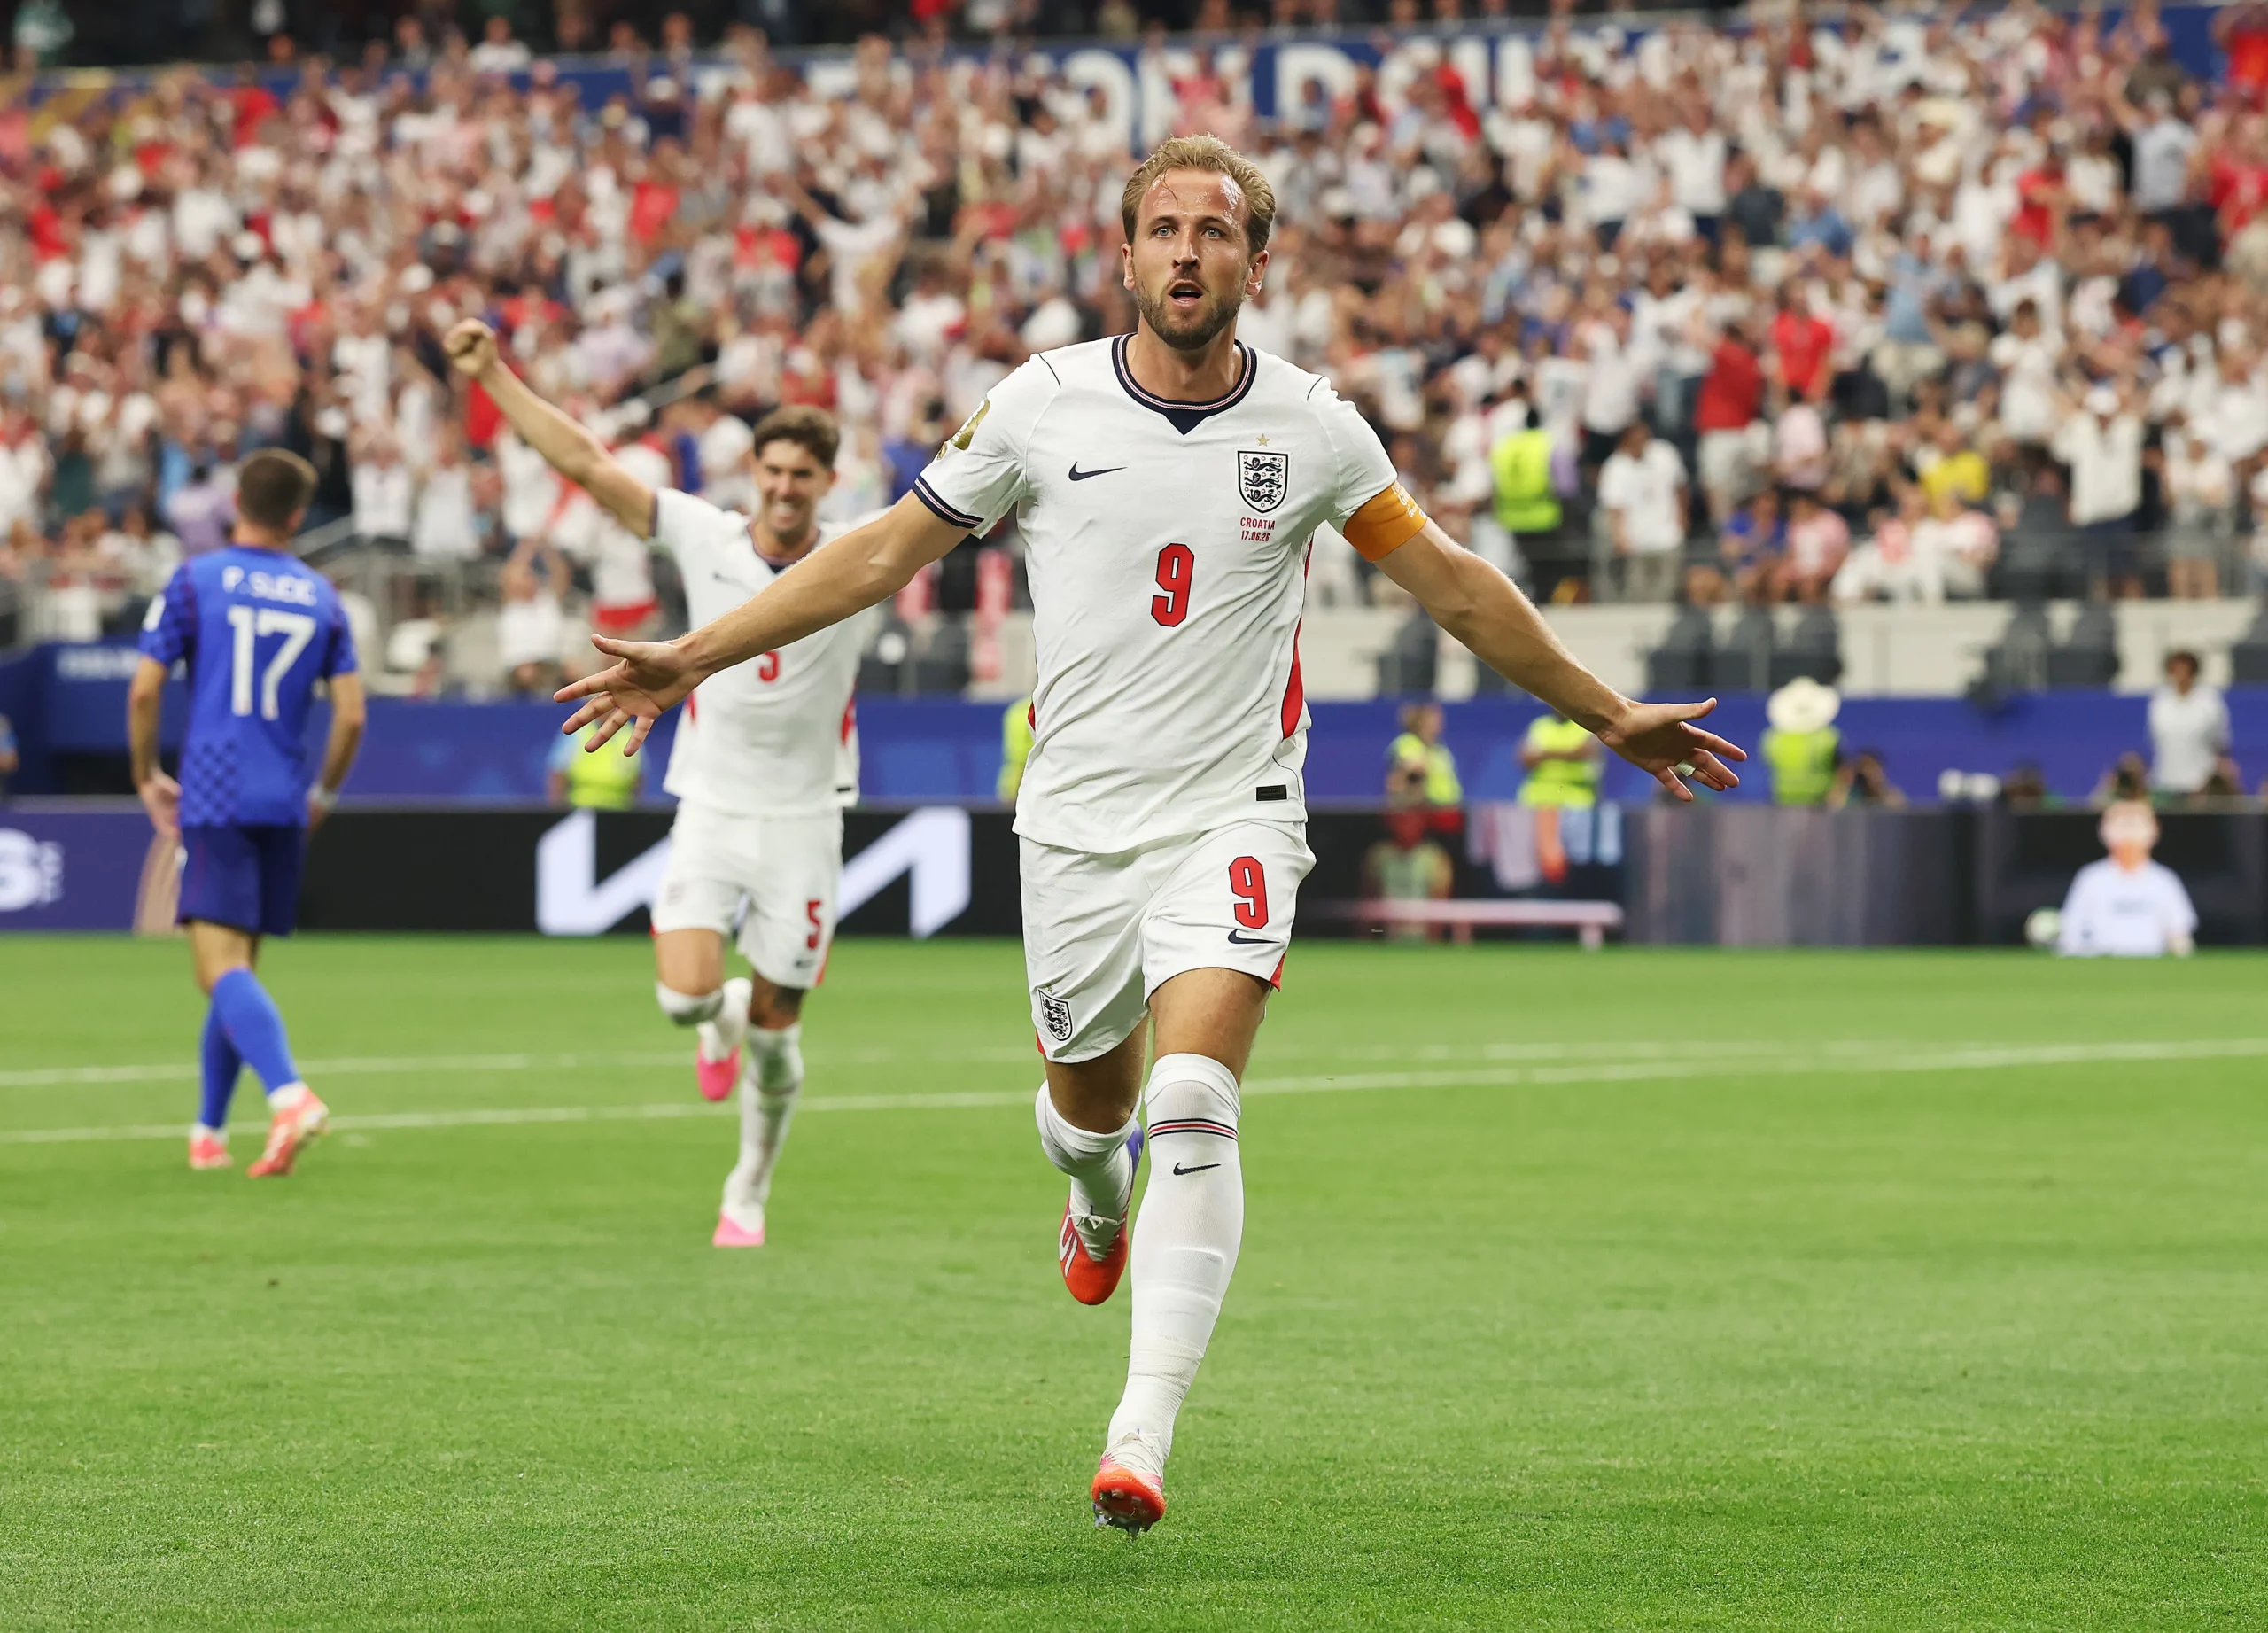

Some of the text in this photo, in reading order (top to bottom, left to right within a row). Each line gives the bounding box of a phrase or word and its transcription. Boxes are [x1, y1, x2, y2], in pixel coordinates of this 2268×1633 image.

[1239, 517, 1276, 530] CROATIA
[1240, 530, 1270, 542] 17.06.26
[1150, 542, 1195, 627] 9
[227, 604, 317, 721] 17
[1228, 856, 1269, 929] 9
[806, 898, 821, 951] 5
